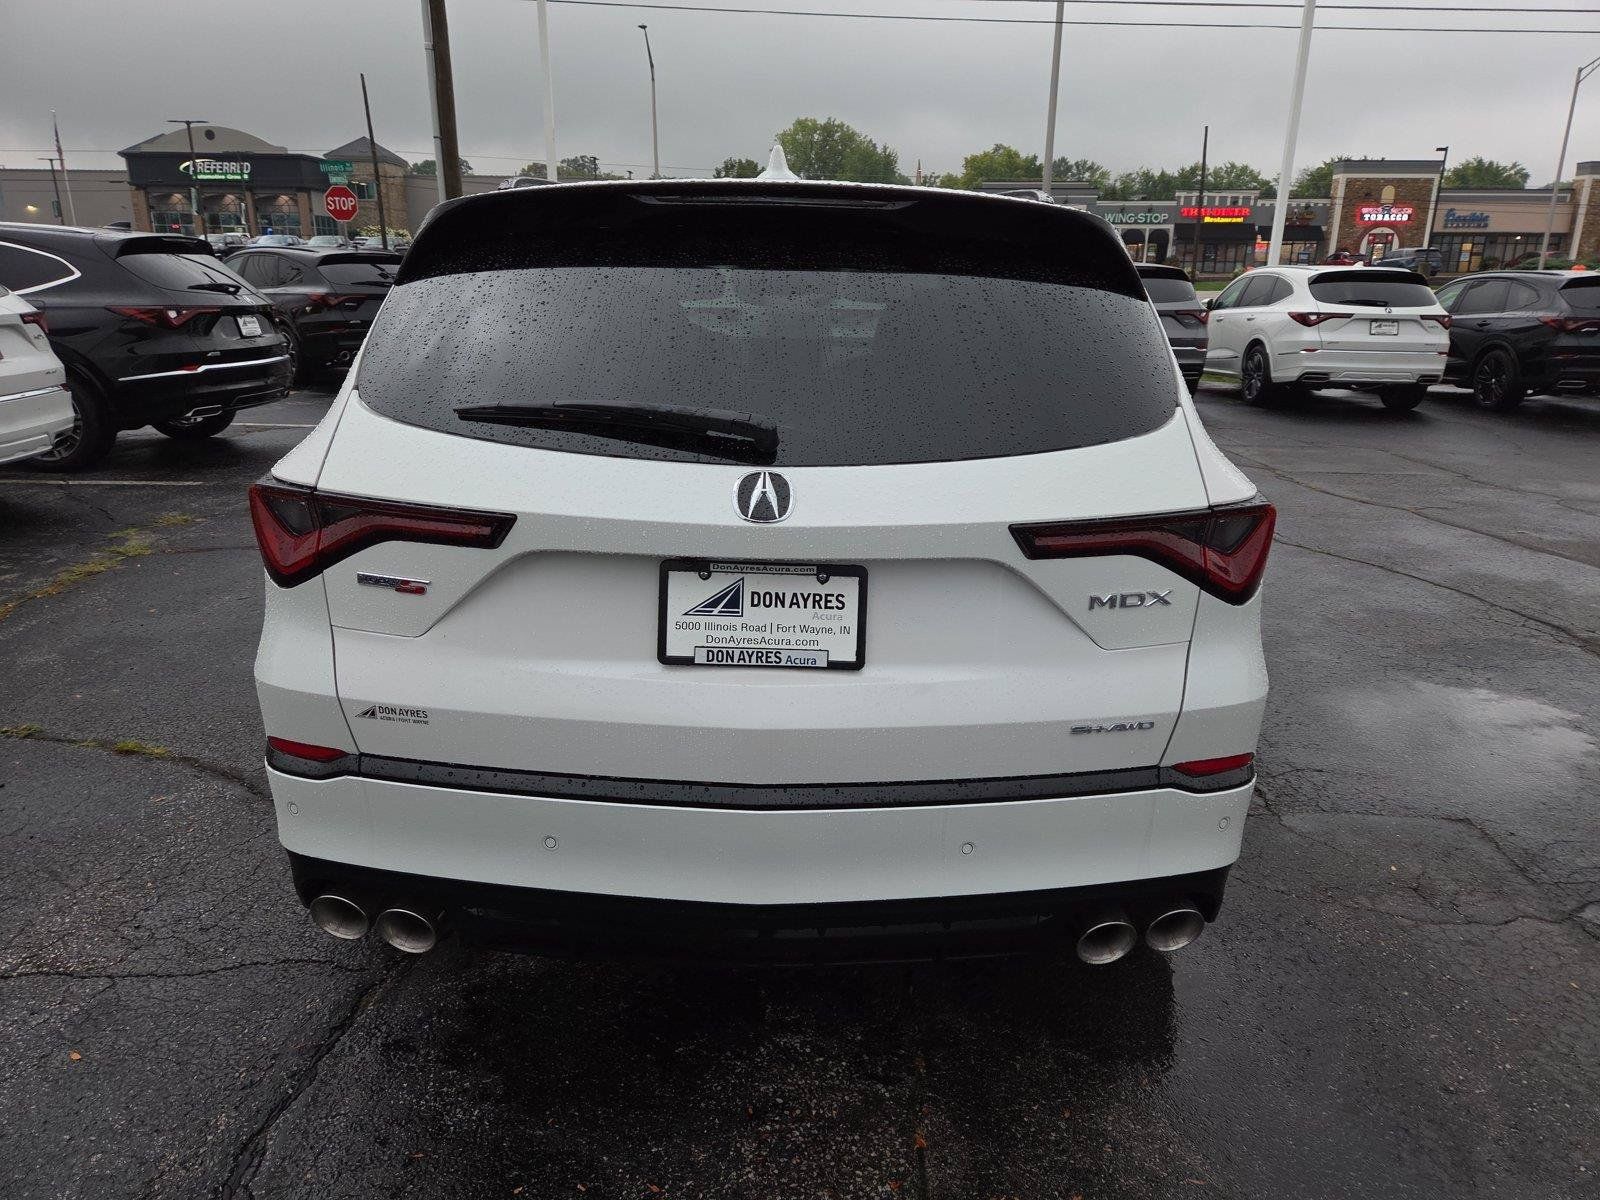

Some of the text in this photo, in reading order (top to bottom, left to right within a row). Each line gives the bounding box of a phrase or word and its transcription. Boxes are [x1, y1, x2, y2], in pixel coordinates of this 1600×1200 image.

[327, 197, 355, 211] STOP
[1363, 213, 1409, 221] TOBACCO
[712, 563, 815, 574] DonAyresAcura.com
[750, 591, 846, 611] DON AYRES
[1088, 589, 1172, 611] MDX
[812, 612, 843, 622] Acura
[675, 621, 851, 636] 5000 Illinois Road Fort Wayne, IN
[706, 634, 819, 648] DonAyresAcura.com
[706, 650, 817, 666] DON AYRES Acura
